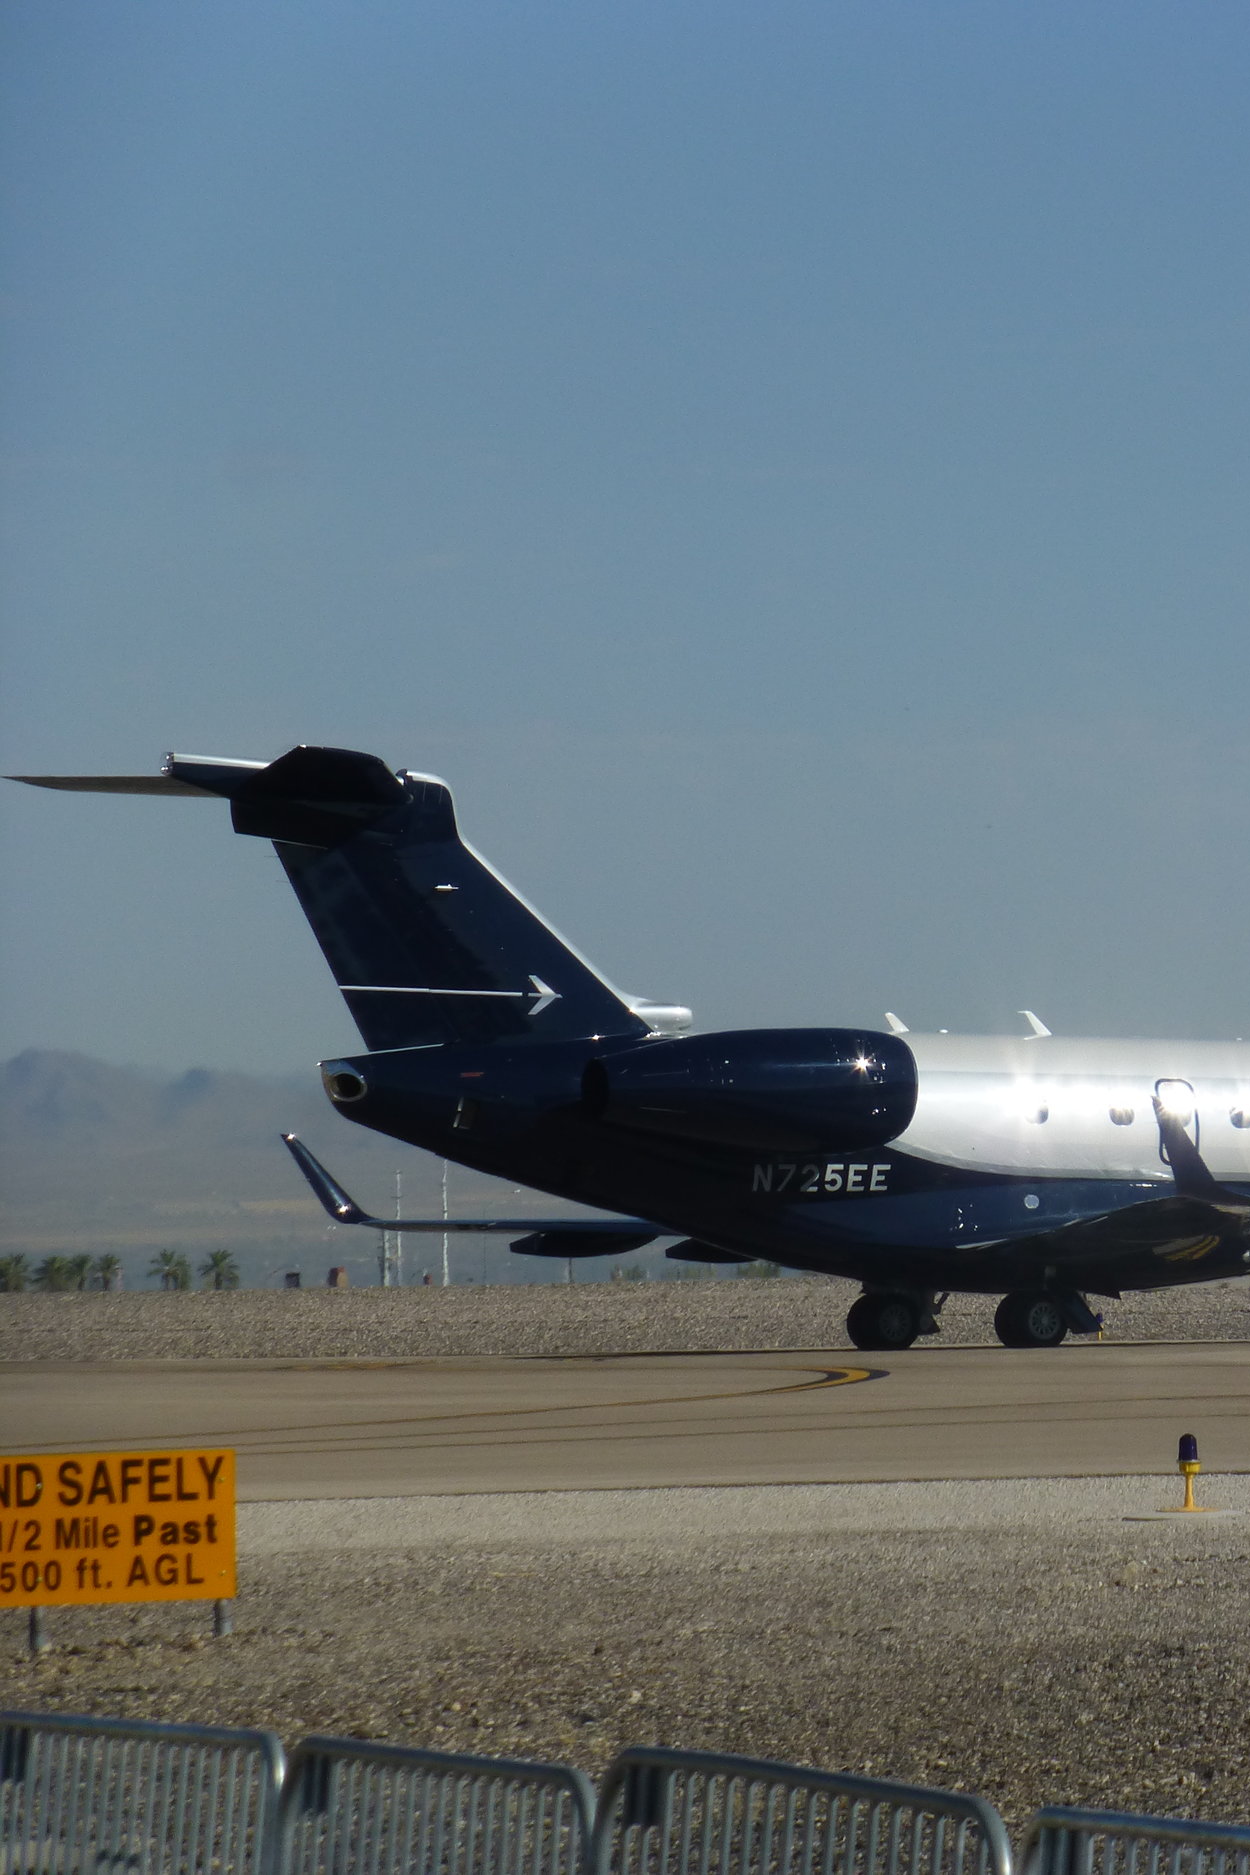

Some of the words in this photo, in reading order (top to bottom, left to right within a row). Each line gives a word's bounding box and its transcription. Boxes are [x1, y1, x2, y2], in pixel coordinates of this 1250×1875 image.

[751, 1163, 892, 1192] N725EE
[57, 1456, 225, 1507] SAFELY
[54, 1516, 119, 1550] Mile
[133, 1514, 218, 1546] Past
[76, 1557, 113, 1590] ft.
[127, 1553, 205, 1587] AGL
